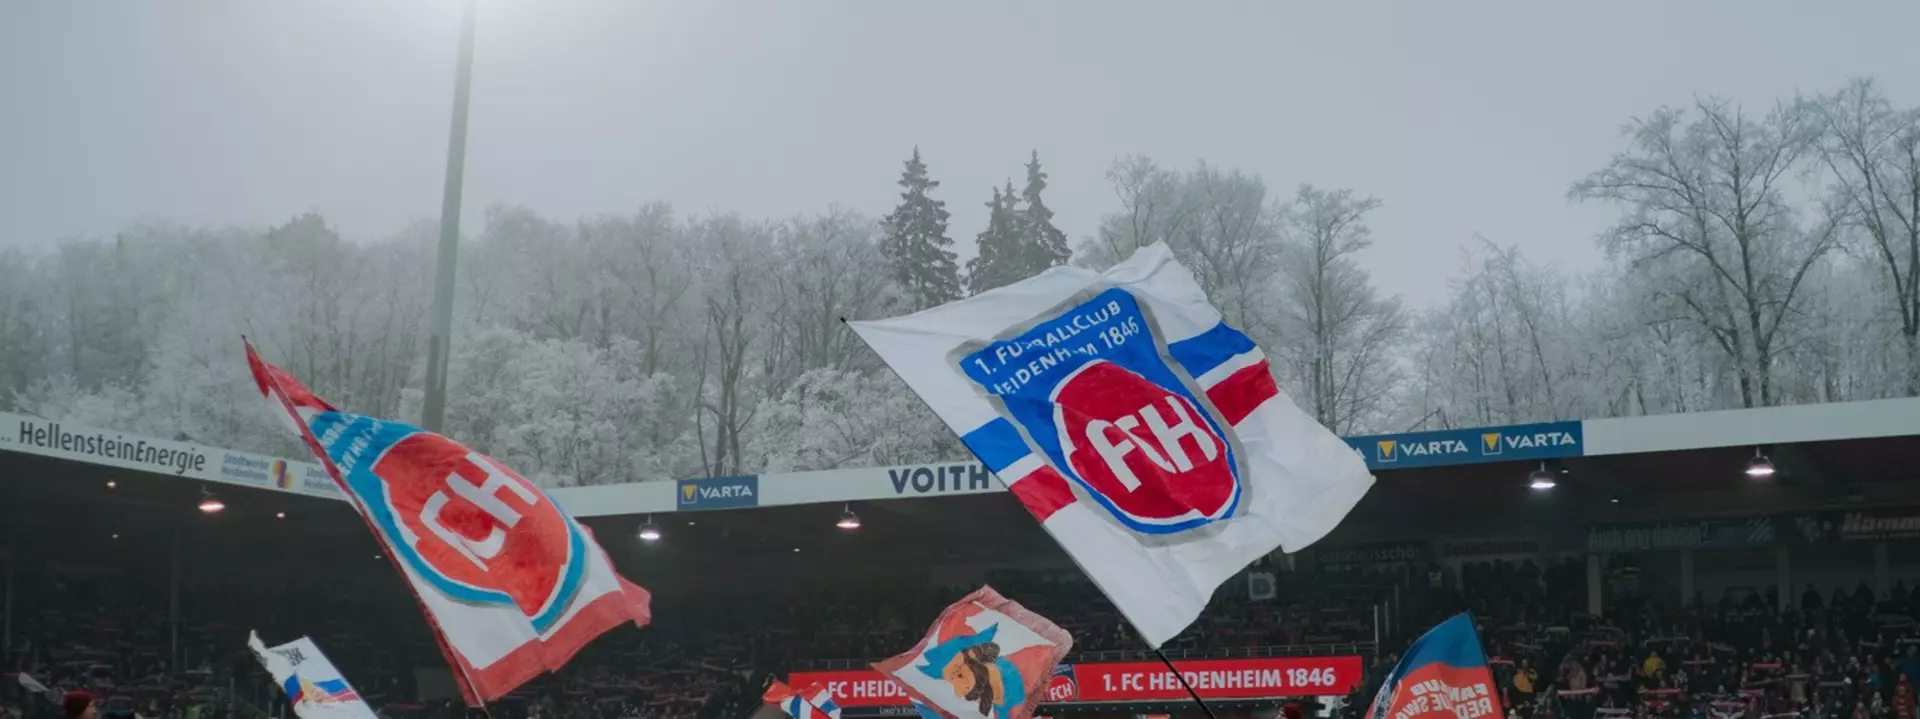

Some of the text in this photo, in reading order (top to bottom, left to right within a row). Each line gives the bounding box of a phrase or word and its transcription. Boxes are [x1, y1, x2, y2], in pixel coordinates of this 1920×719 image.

[1099, 316, 1140, 349] 1846
[974, 357, 997, 375] 1.
[20, 421, 205, 475] HellensteinEnergie
[1085, 395, 1218, 493] FCH
[1400, 440, 1468, 457] VARTA
[1505, 432, 1575, 449] VARTA
[888, 465, 989, 494] VOITH
[699, 485, 753, 499] VARTA
[420, 452, 539, 572] CH
[1103, 667, 1336, 691] 1. FC HEIDENHEIM 1846
[828, 681, 849, 699] FC
[1050, 683, 1073, 701] FCH
